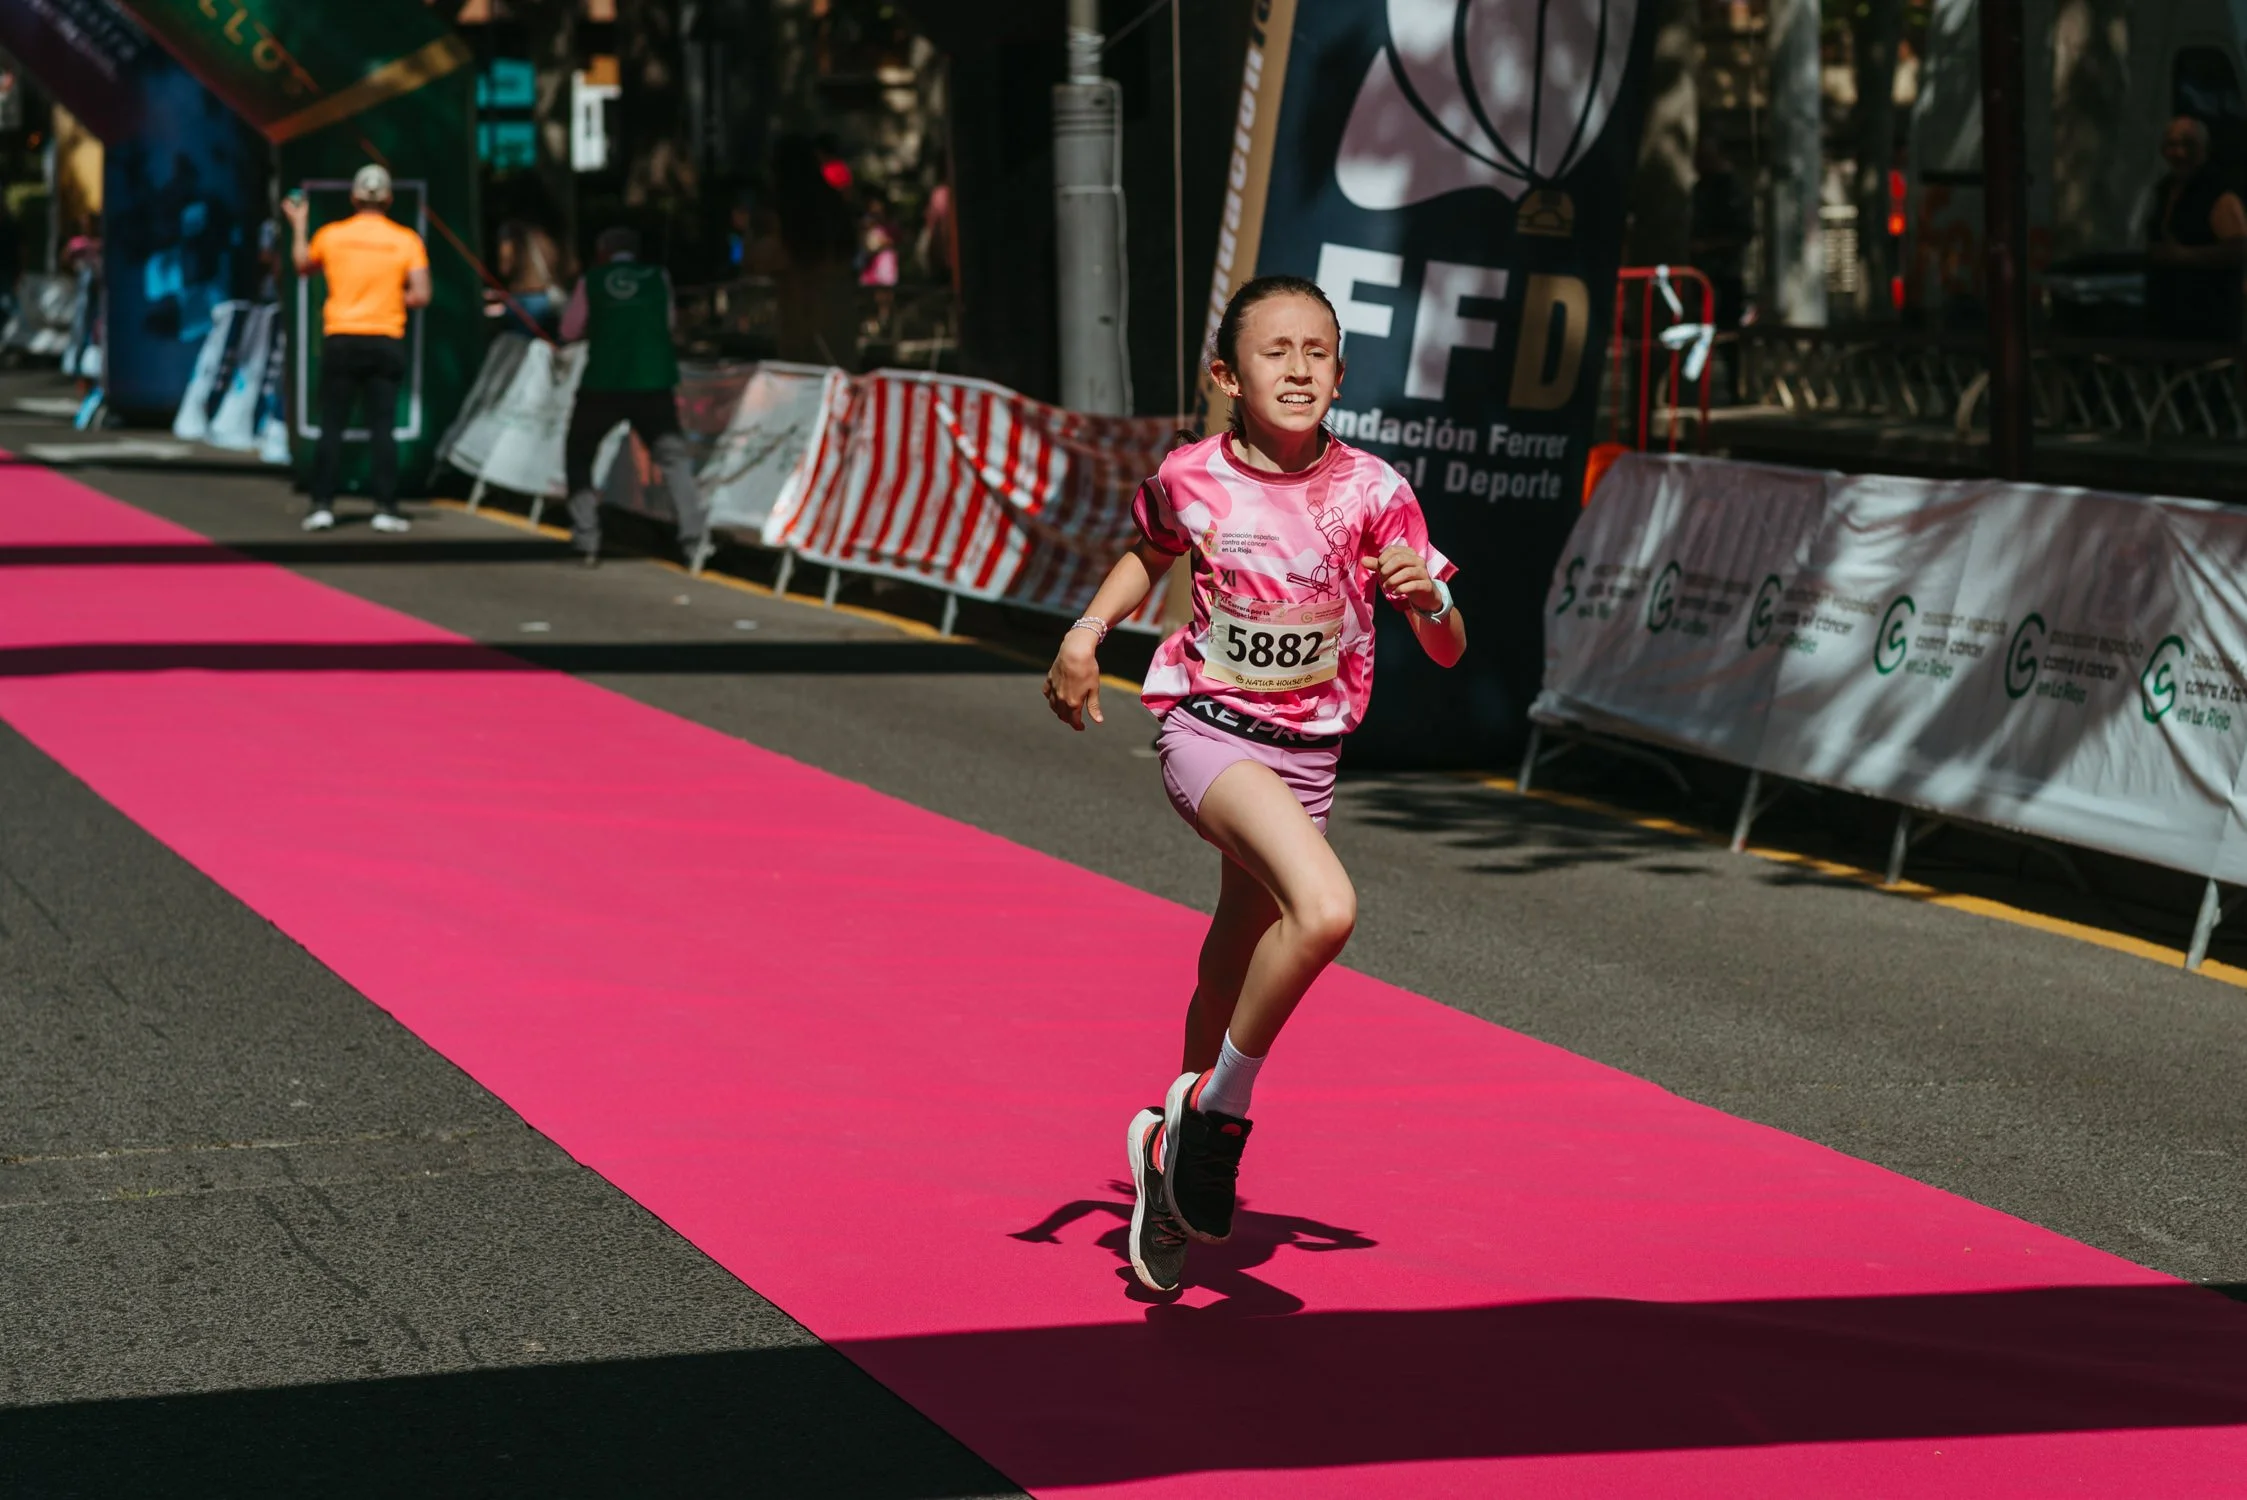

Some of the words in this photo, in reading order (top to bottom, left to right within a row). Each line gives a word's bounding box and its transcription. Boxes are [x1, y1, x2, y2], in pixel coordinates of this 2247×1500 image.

[1320, 407, 1477, 453] undación
[1488, 423, 1569, 460] Ferrer
[1445, 461, 1561, 503] Deporte
[1220, 569, 1237, 587] XI
[1226, 623, 1324, 668] 5882
[1245, 679, 1274, 687] NATUR
